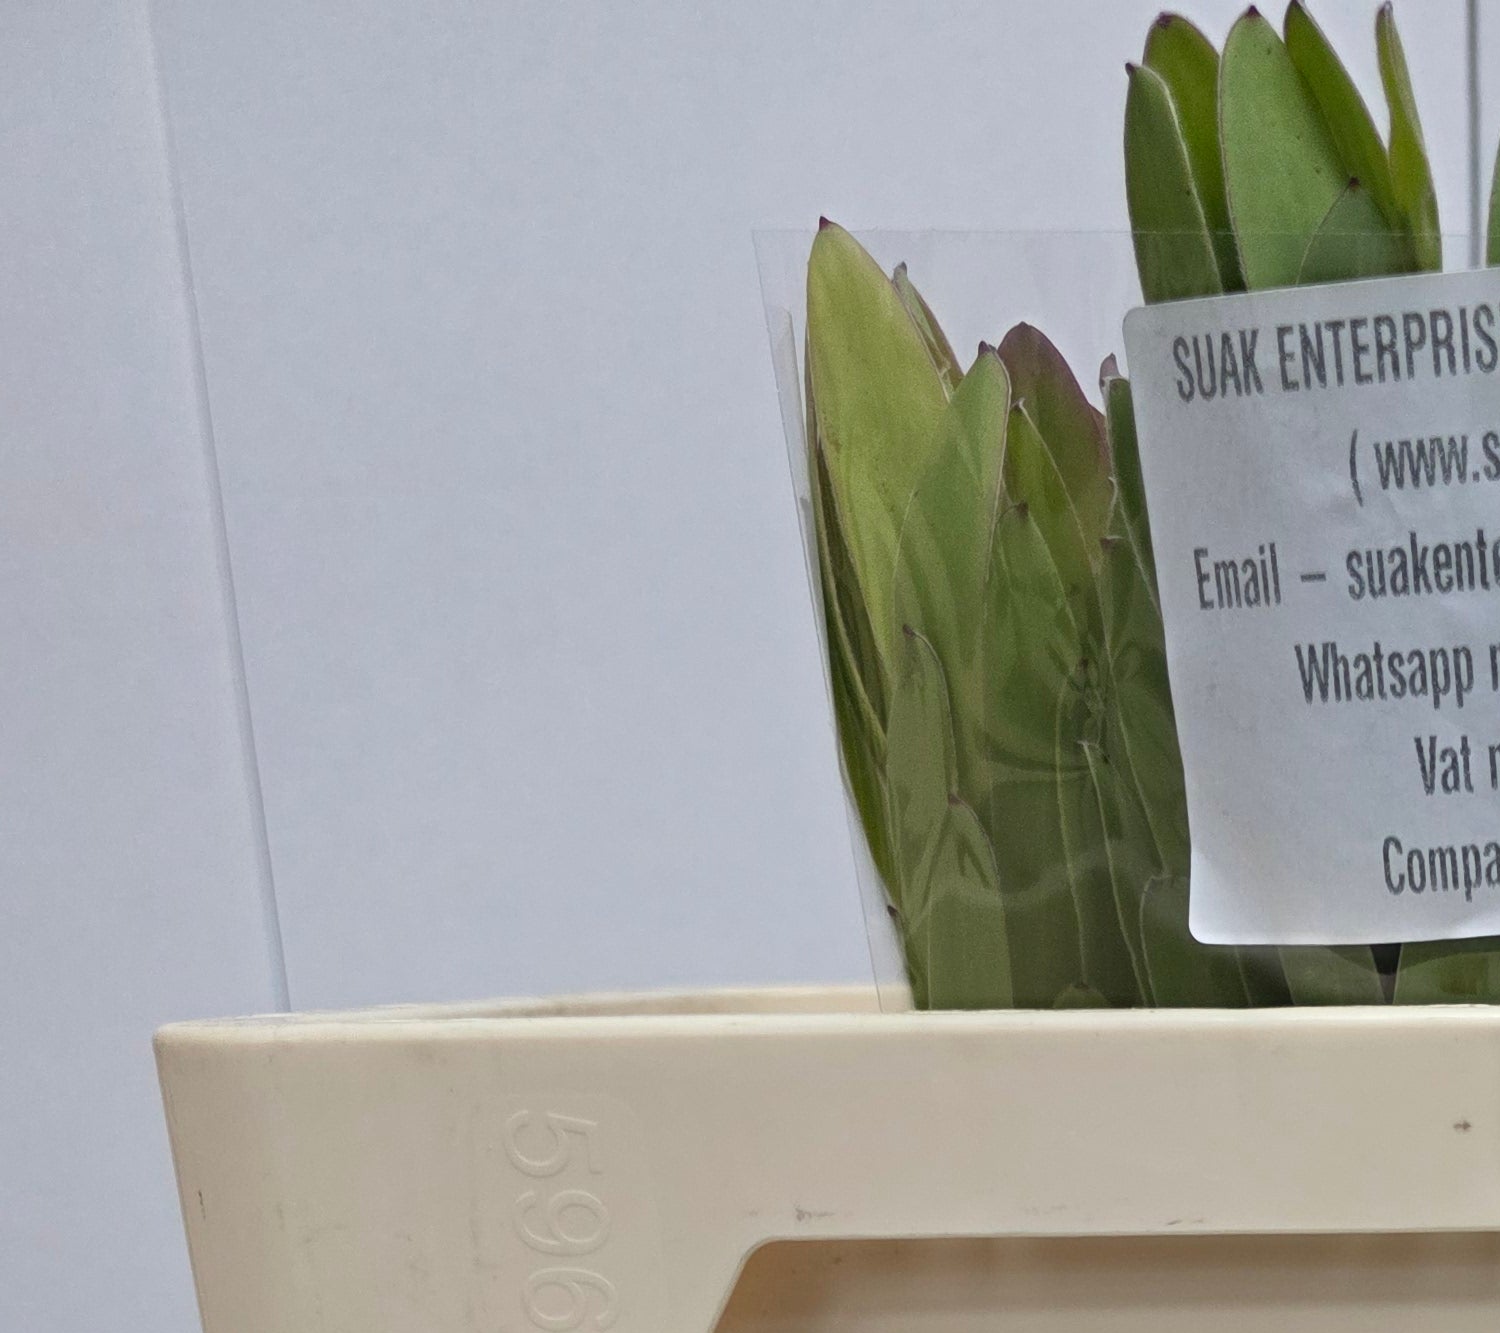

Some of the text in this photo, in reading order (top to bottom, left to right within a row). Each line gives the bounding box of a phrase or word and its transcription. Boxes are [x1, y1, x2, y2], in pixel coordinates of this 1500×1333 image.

[1172, 328, 1264, 404] SUAK
[1193, 542, 1282, 610] Email
[1293, 641, 1474, 710] Whatsapp
[1413, 735, 1474, 796] Vat
[503, 1109, 620, 1333] 596
